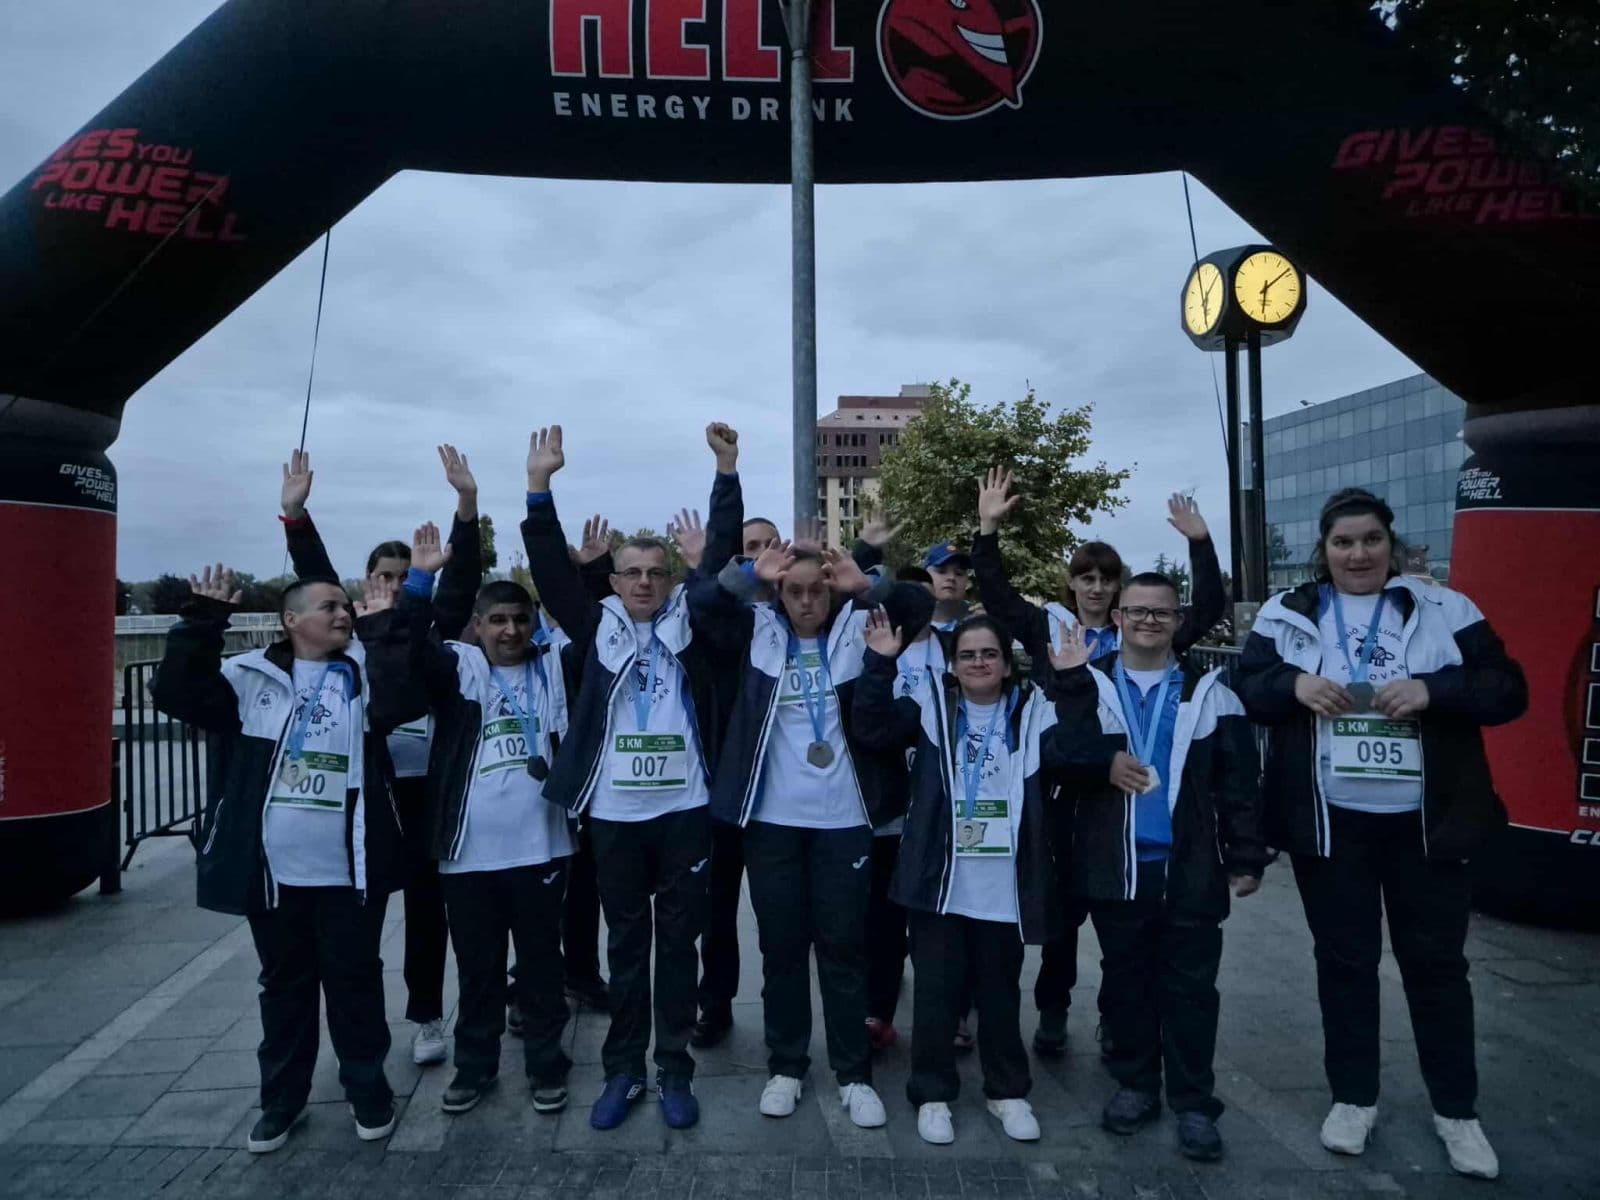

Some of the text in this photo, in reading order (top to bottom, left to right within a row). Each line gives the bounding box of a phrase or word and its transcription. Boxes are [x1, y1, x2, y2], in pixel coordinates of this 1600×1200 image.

[553, 91, 854, 122] ENERGY DRNK
[137, 143, 192, 166] YOU
[31, 159, 231, 207] POWER
[44, 191, 248, 246] LIKE HELL
[58, 463, 103, 480] GIVES
[1469, 488, 1504, 501] HELL
[484, 724, 501, 738] KM
[1336, 720, 1345, 734] 5
[1347, 720, 1369, 734] KM
[493, 737, 528, 759] 102
[617, 737, 626, 749] 5
[626, 737, 643, 750] KM
[1356, 740, 1403, 765] 095
[631, 755, 668, 777] 007
